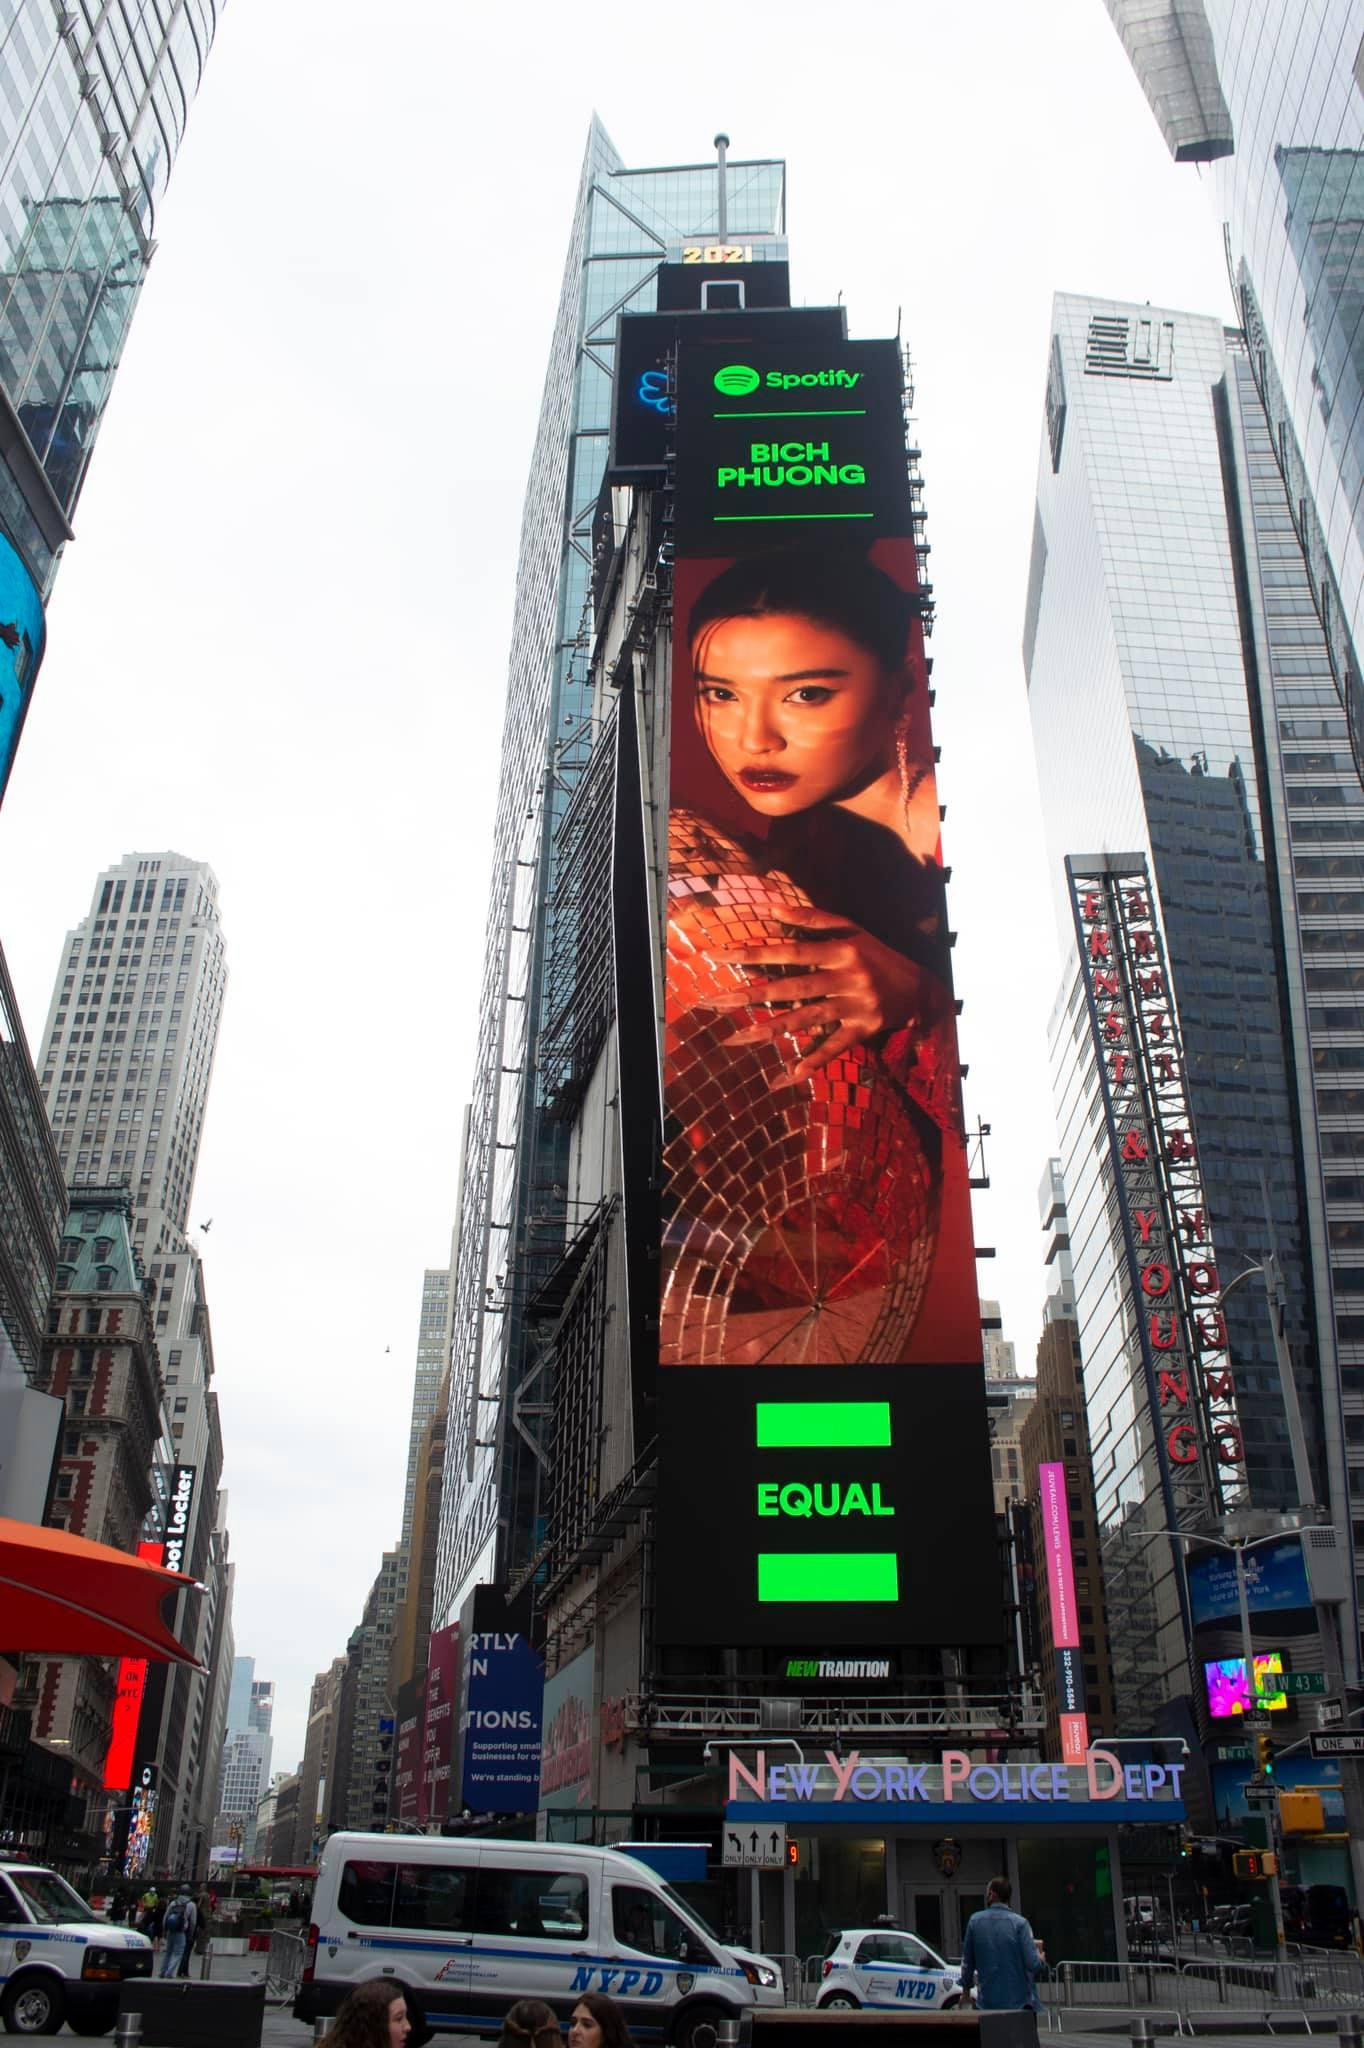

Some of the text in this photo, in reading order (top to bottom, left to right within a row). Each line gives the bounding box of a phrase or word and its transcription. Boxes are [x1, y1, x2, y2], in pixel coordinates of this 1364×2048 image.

[683, 245, 752, 264] 2021
[766, 369, 860, 390] Spotify
[750, 442, 829, 463] BICH
[718, 464, 865, 487] PHUONG
[1084, 892, 1198, 1464] ERNST & YOUNG
[758, 1482, 895, 1518] EQUAL
[1278, 1676, 1289, 1690] W
[1295, 1675, 1311, 1691] 43
[473, 1742, 541, 1752] Supporting small
[1321, 1738, 1345, 1750] ONE
[472, 1752, 514, 1760] businesses
[517, 1752, 529, 1760] for
[472, 1773, 494, 1781] We're
[497, 1773, 535, 1783] standing
[1085, 1749, 1187, 1800] DEPT
[725, 1855, 783, 1864] ONLY ONLY ONLY
[790, 1846, 798, 1863] 9
[47, 1932, 76, 1944] POLICE
[707, 1967, 736, 1976] POLICE
[569, 1966, 663, 1996] NYPD
[895, 1979, 936, 2000] NYPD
